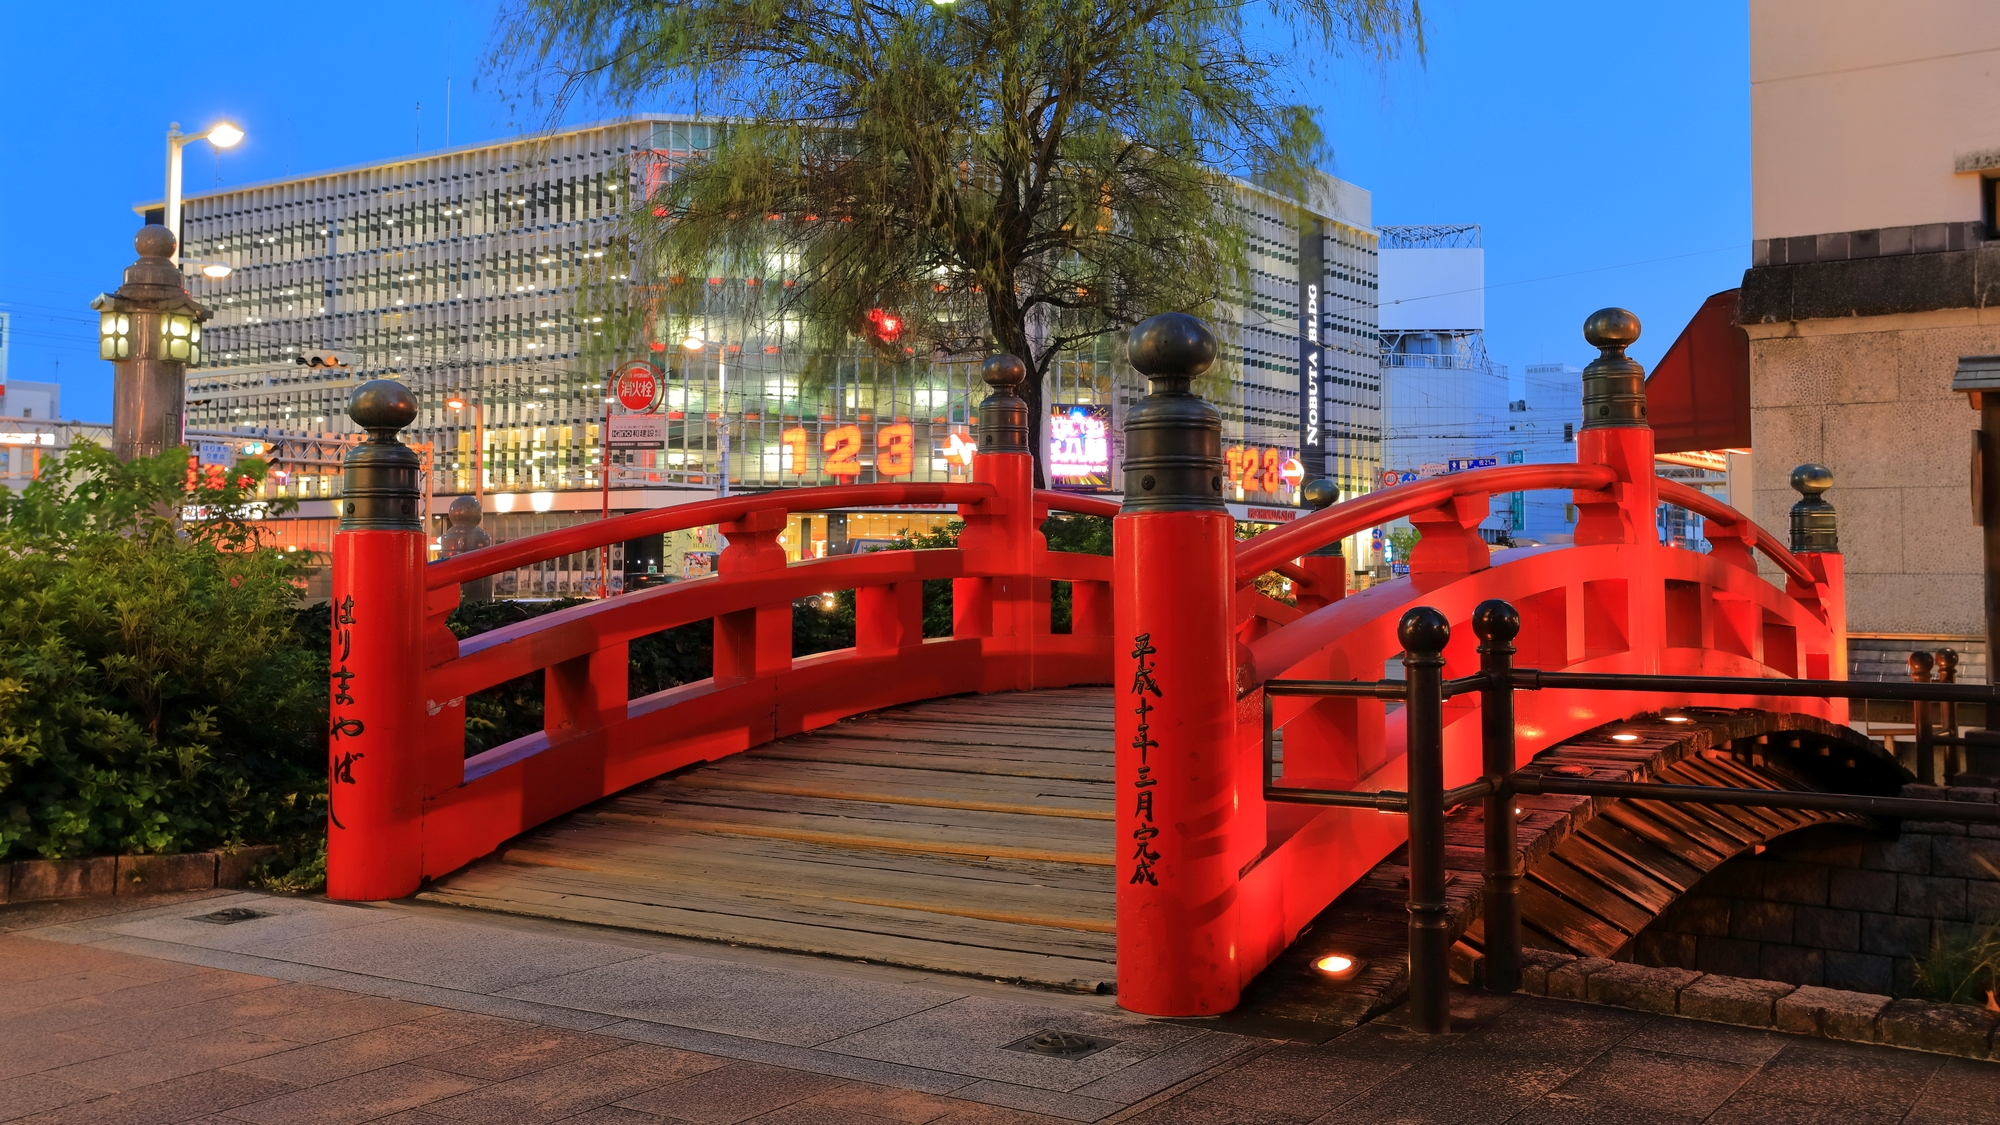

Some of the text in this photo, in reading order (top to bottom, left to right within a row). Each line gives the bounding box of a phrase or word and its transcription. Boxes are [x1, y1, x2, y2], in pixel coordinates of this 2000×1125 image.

[620, 380, 653, 398] 消火栓
[1307, 284, 1318, 447] NOBUTA BLDG
[202, 445, 229, 453] はりまや
[782, 423, 915, 476] 123
[1225, 447, 1279, 492] 123
[329, 594, 365, 830] はりまやばし
[1130, 632, 1163, 886] 平成十年三月完成
